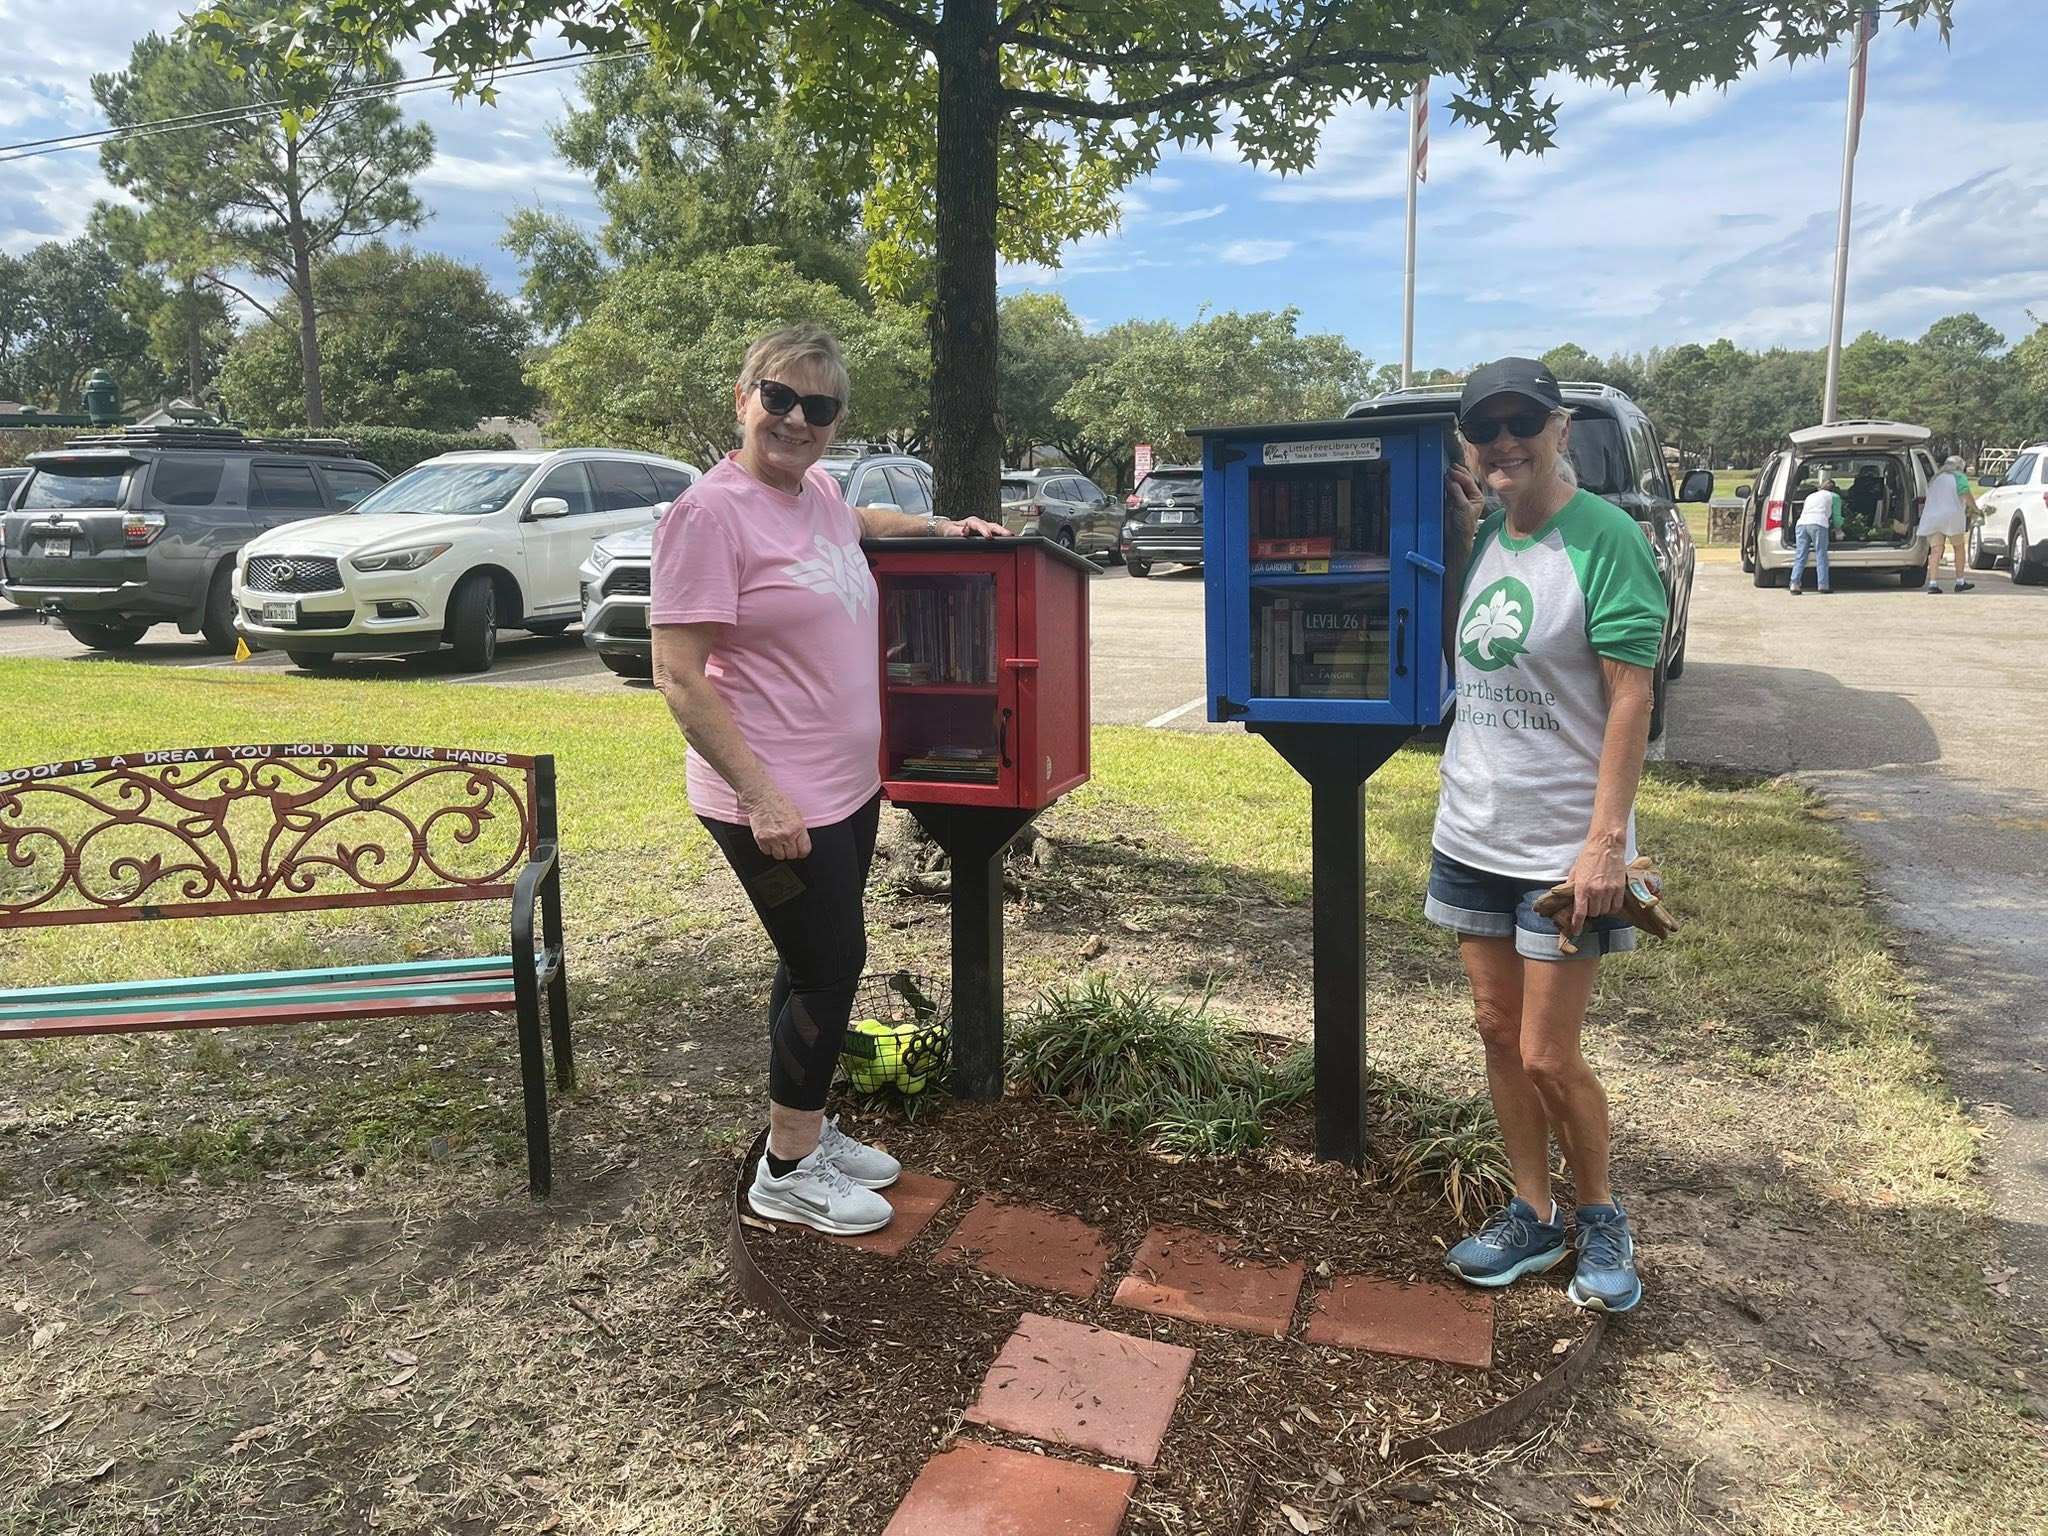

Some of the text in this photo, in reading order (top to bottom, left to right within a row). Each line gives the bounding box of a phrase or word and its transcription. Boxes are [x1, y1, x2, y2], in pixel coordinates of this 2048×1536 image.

[1289, 442, 1376, 453] LittleFreeLibrary.org
[1265, 562, 1292, 572] GARDNER
[1343, 613, 1359, 629] 26
[1502, 708, 1560, 732] Club
[0, 763, 63, 784] BOOK
[73, 759, 97, 772] IS
[110, 755, 127, 767] A
[227, 746, 272, 759] YOU
[284, 745, 334, 756] HOLD
[346, 744, 368, 756] IN
[381, 745, 435, 759] YOUR
[446, 750, 508, 764] HANDS
